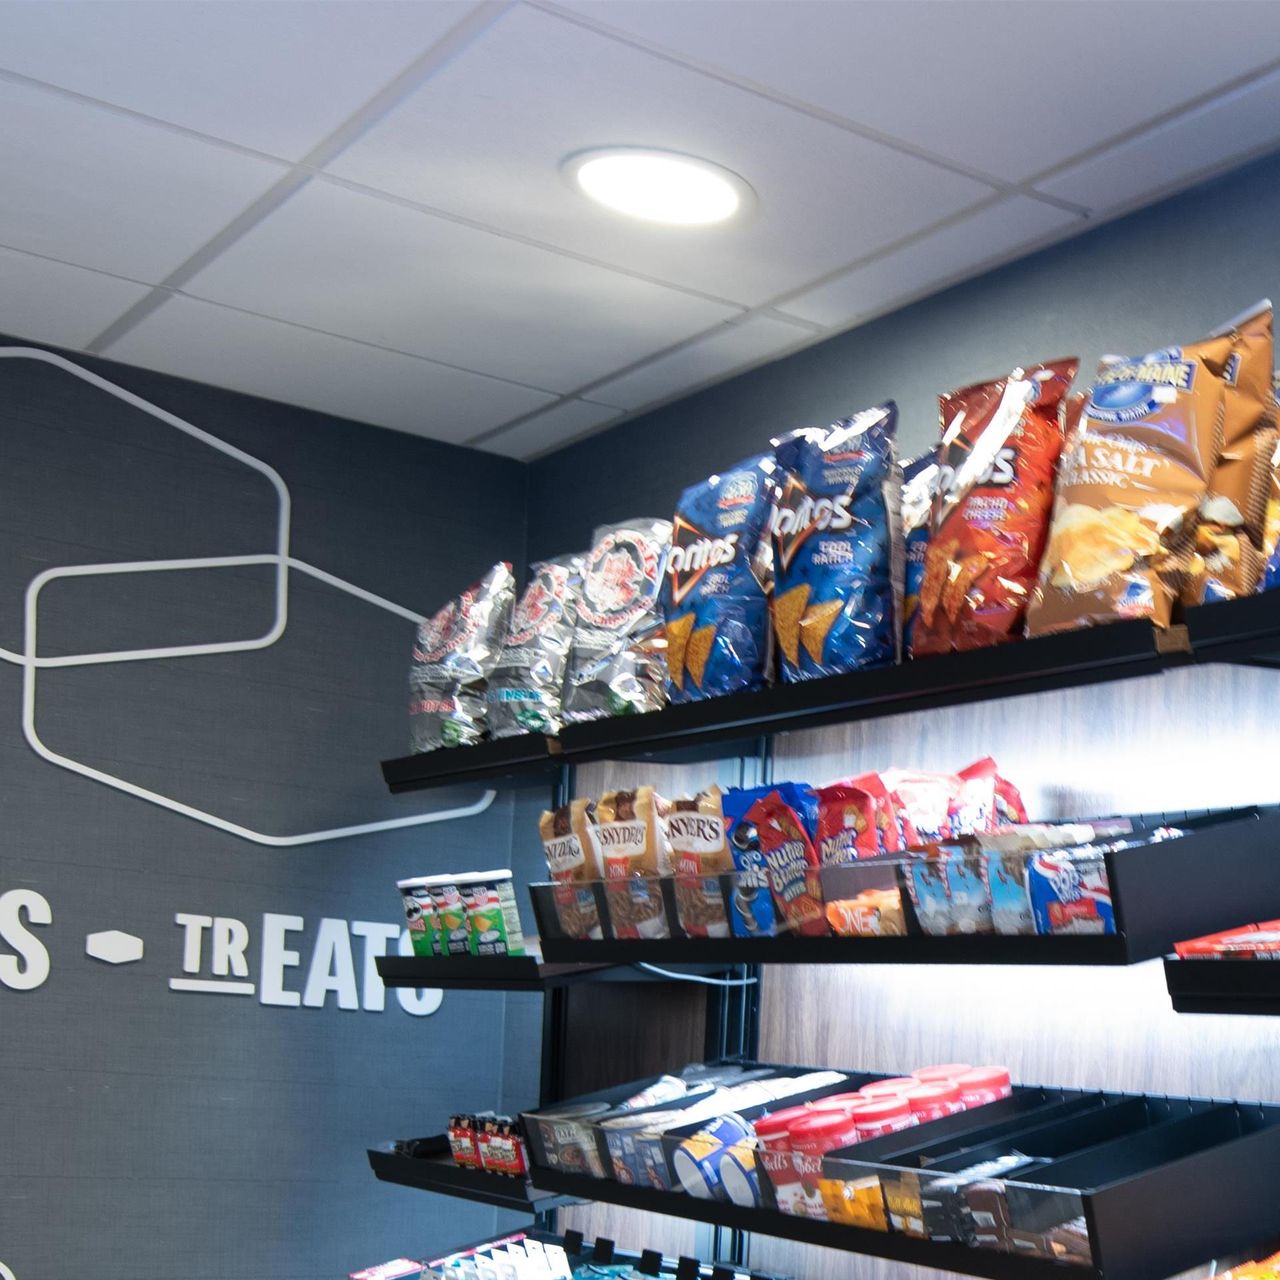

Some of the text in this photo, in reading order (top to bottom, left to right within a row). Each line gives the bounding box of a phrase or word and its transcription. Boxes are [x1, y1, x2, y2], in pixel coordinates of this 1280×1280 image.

[1136, 361, 1191, 389] MAINE
[1090, 446, 1161, 478] SALT
[770, 494, 853, 538] oritos
[666, 533, 739, 575] oritos
